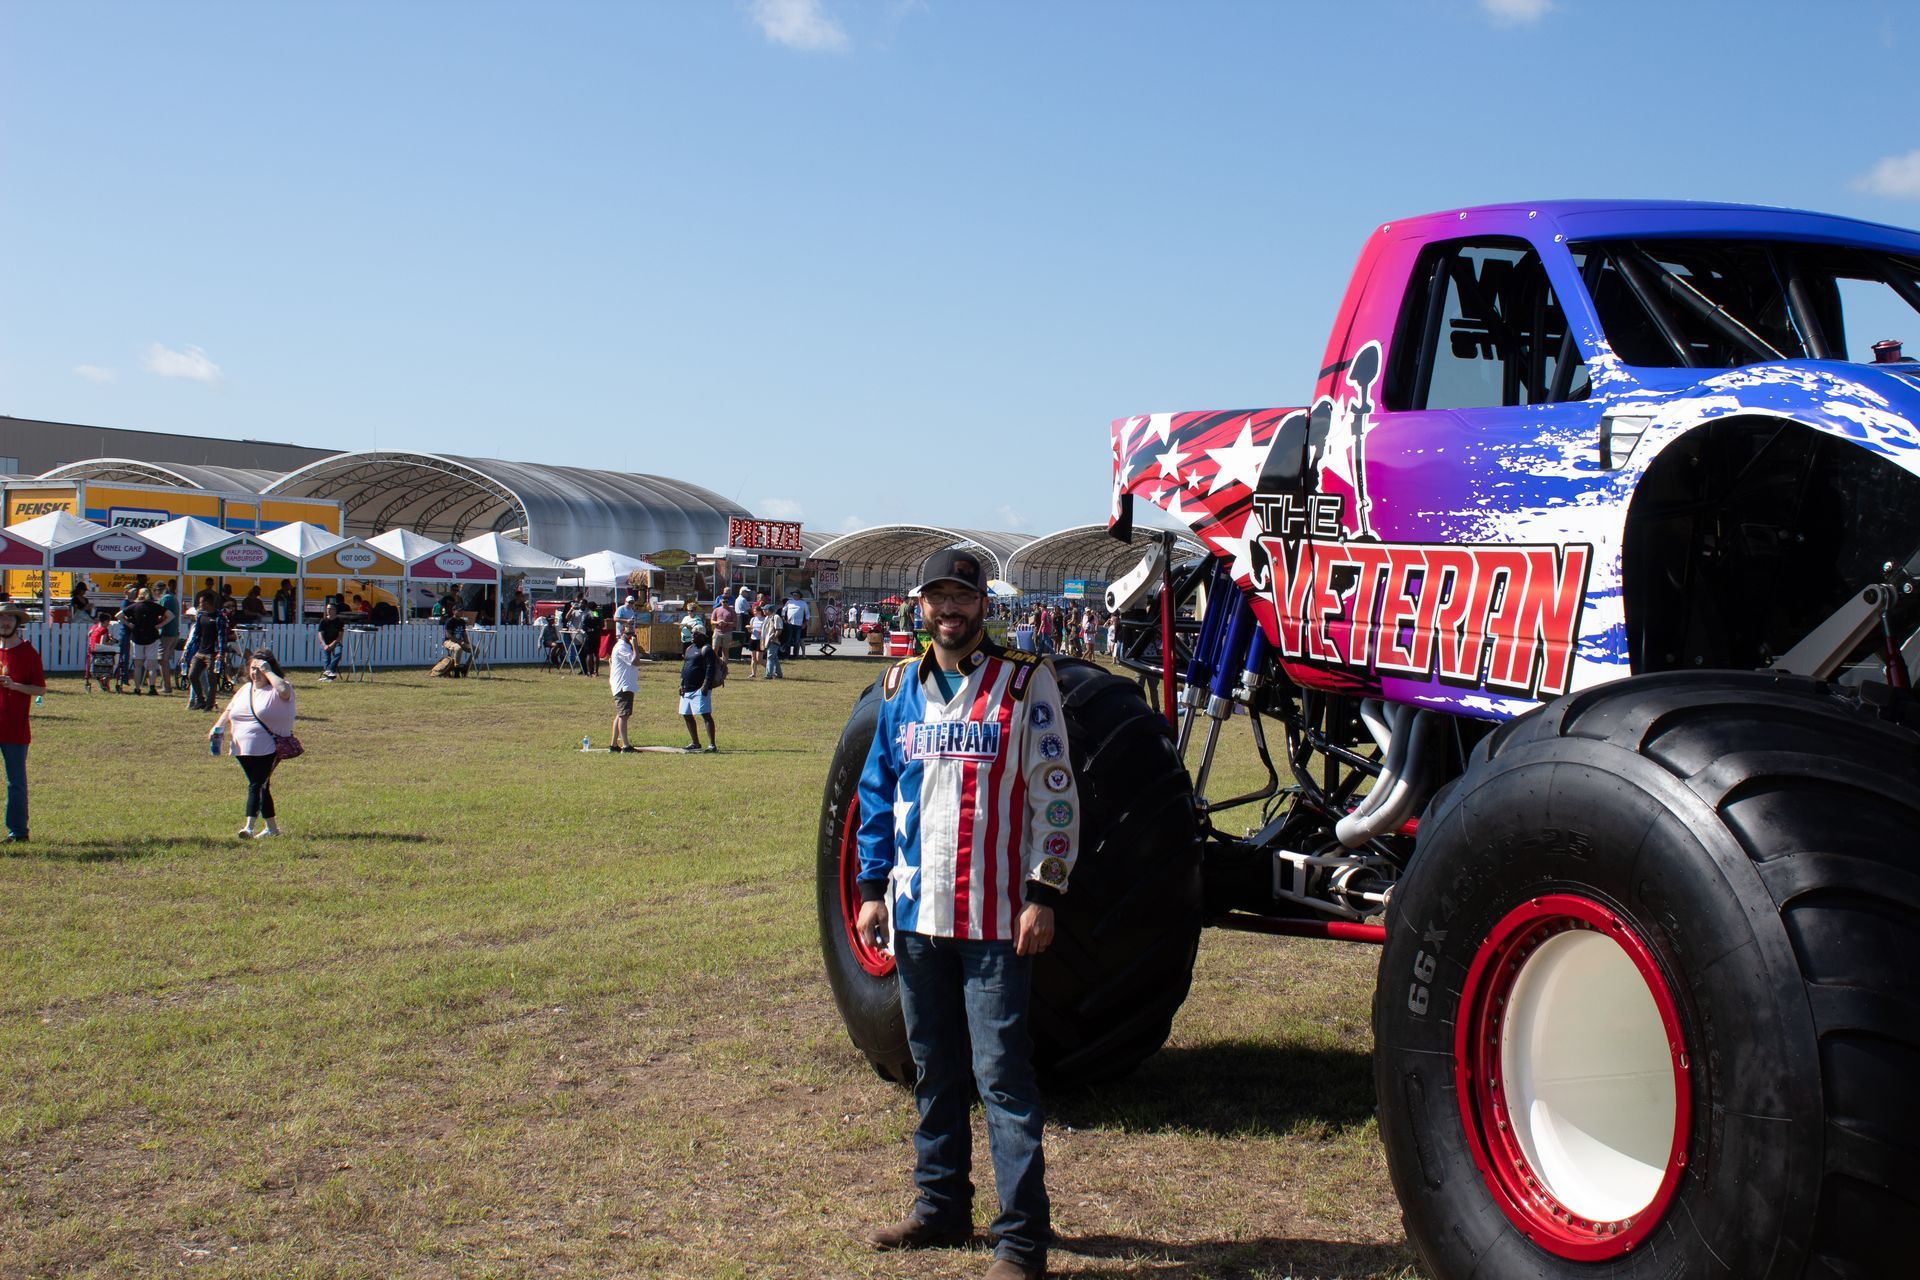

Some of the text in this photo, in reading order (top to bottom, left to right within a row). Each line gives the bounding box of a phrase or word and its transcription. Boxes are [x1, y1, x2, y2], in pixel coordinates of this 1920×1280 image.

[15, 502, 71, 515] PENSKE
[1253, 494, 1342, 536] THE
[114, 516, 166, 528] PENSKE
[731, 518, 802, 551] PRETZEL
[96, 544, 142, 553] FUNNEL CAKE
[341, 554, 371, 562] HOT DOGS
[442, 558, 465, 567] NACHOS
[1259, 535, 1592, 698] VETERAN
[1003, 650, 1037, 664] NAPA
[901, 721, 1001, 763] VETERAN
